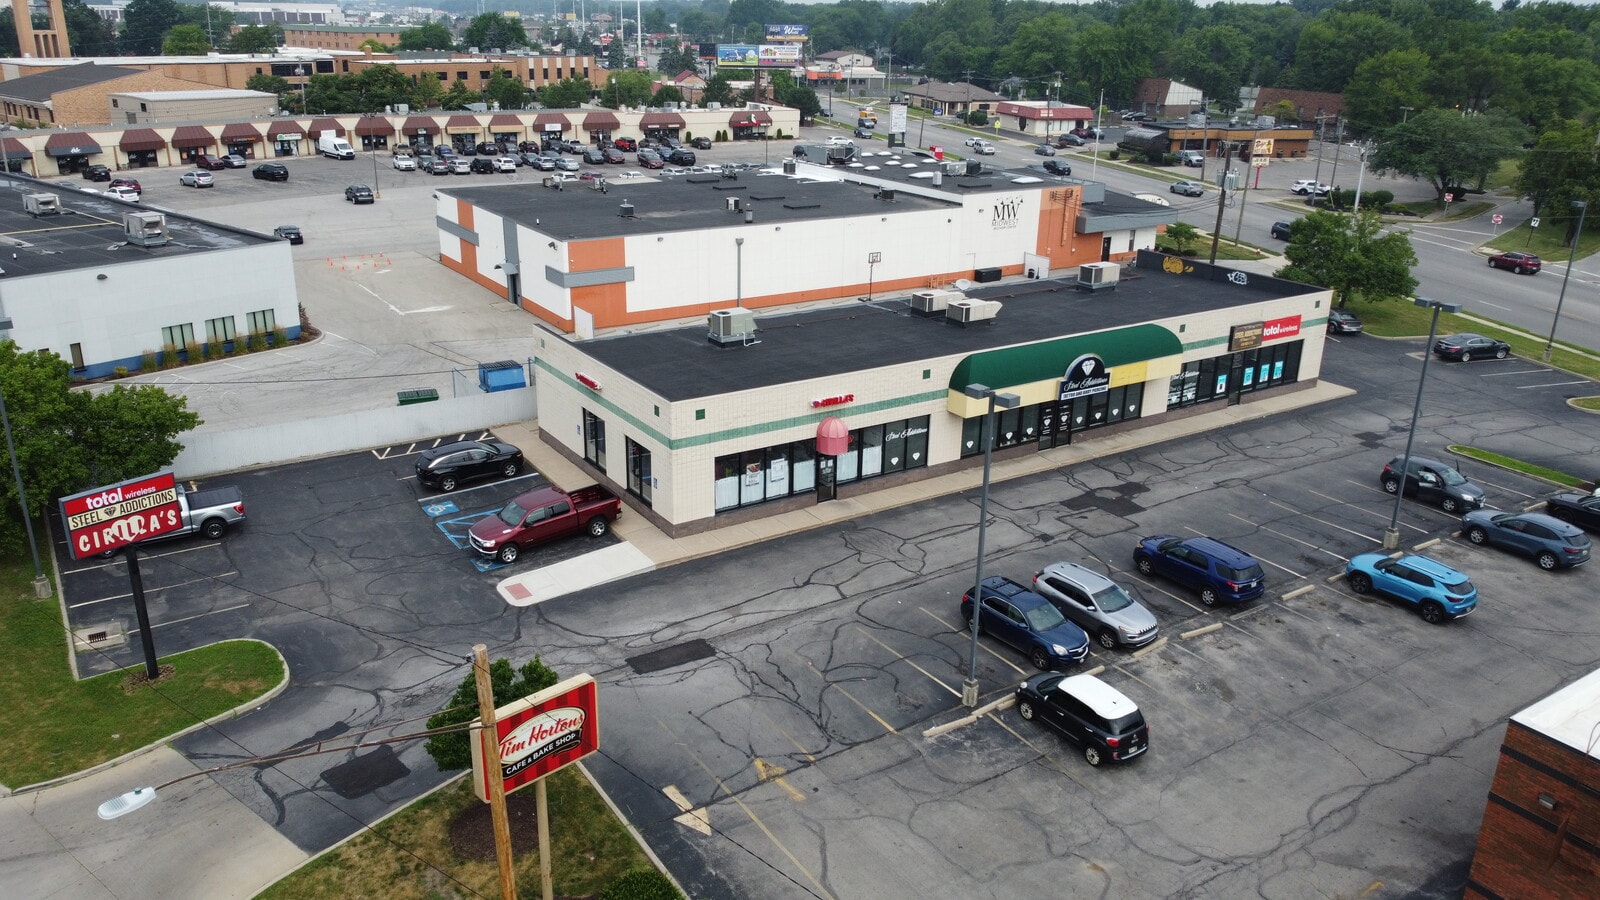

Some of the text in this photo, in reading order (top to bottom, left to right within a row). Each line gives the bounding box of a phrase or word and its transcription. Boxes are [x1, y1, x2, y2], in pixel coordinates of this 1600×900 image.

[993, 203, 1020, 221] MW
[1263, 323, 1298, 337] total wireless
[71, 490, 174, 529] STEEL ADDICTIONS
[86, 486, 156, 510] total wireless
[499, 735, 526, 760] Tim
[527, 713, 585, 747] Hortons
[506, 760, 527, 775] CAFE
[533, 743, 554, 760] BAKE
[555, 733, 576, 748] SHOP
